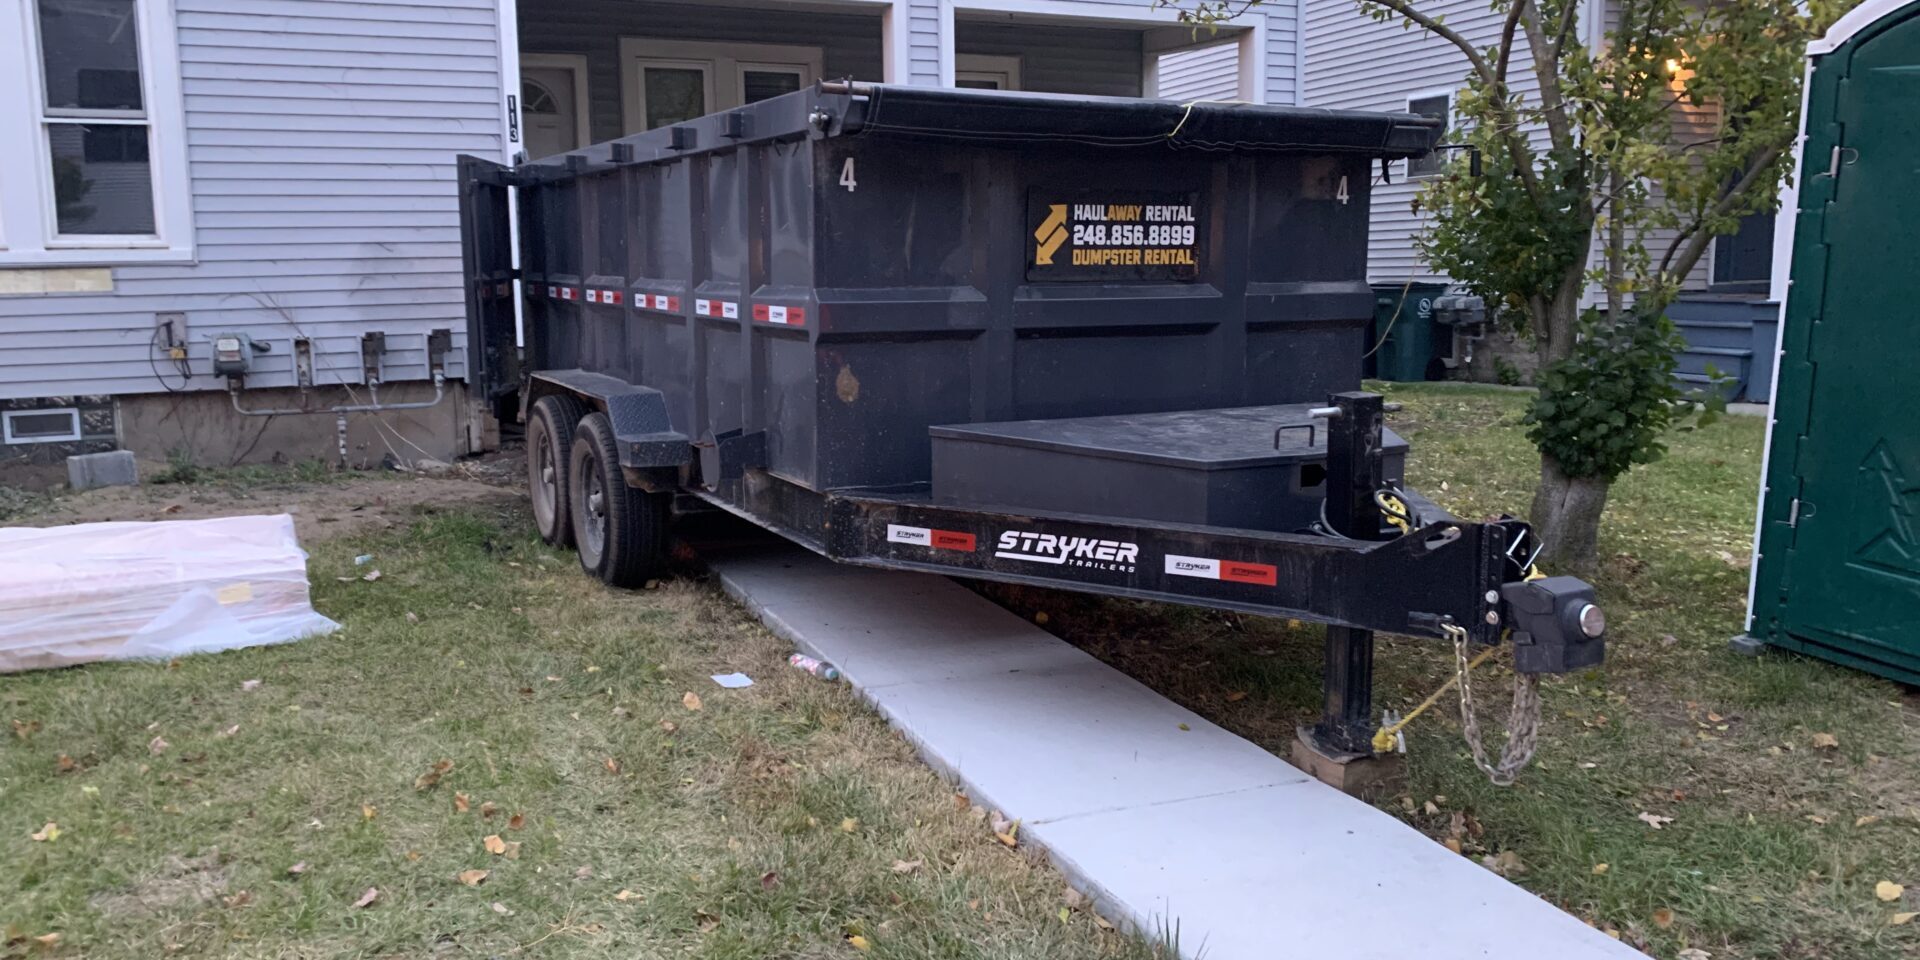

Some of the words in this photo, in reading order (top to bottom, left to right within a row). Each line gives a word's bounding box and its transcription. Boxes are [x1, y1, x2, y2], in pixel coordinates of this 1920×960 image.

[509, 96, 517, 141] 113
[839, 157, 858, 192] 4
[1336, 175, 1350, 205] 4
[1074, 204, 1142, 221] HAULAWAY
[1145, 205, 1195, 221] RENTAL
[1073, 224, 1195, 246] 248.856.8899
[1072, 249, 1141, 265] DUMPSTER
[1144, 249, 1194, 265] RENTAL
[995, 530, 1139, 564] STRYKER
[1068, 558, 1136, 573] TRAILERS
[1175, 561, 1211, 571] STRYKER
